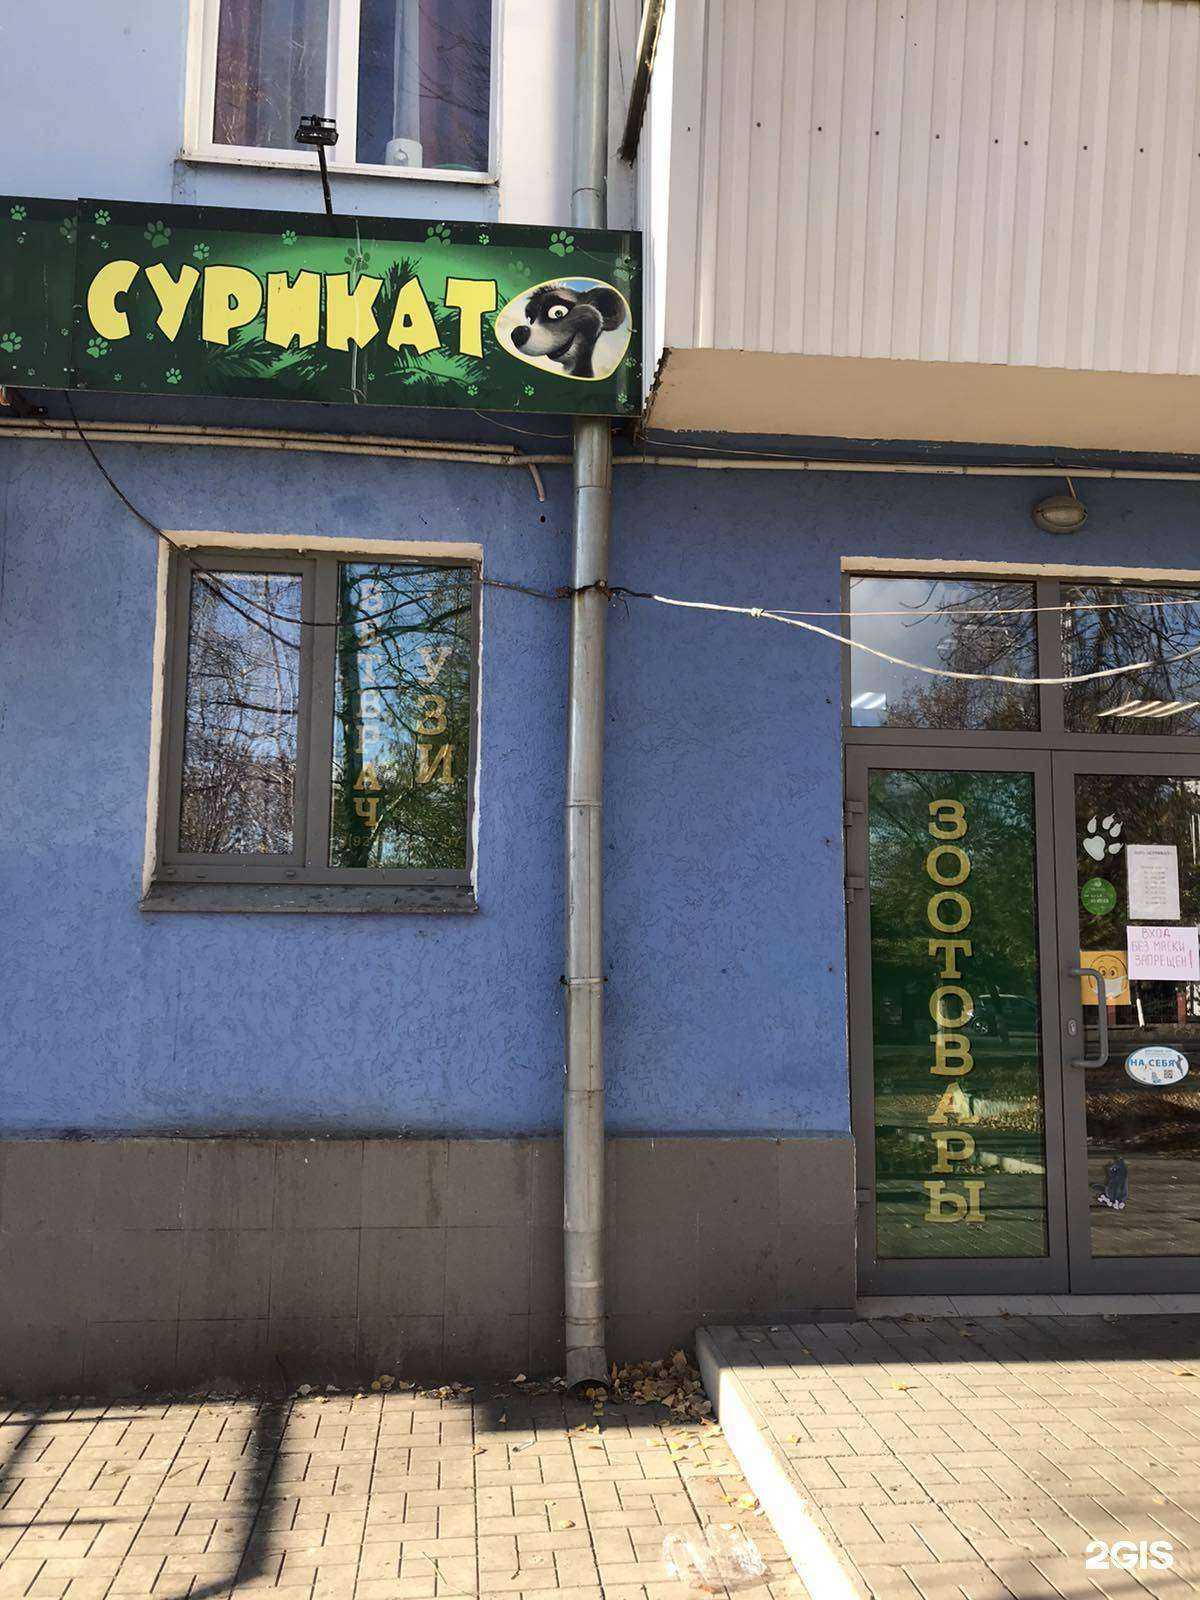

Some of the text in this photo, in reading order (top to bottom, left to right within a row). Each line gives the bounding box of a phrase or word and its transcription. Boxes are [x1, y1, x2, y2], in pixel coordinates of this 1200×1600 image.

[87, 259, 498, 359] СУРИКАТ
[416, 646, 455, 785] УЗИ
[1131, 940, 1185, 952] БЕЗ МАСКИ
[1142, 928, 1171, 939] ВХОД
[924, 799, 986, 1224] ЗООТОВАРЫ
[1130, 1058, 1176, 1067] НА СЕБЯ
